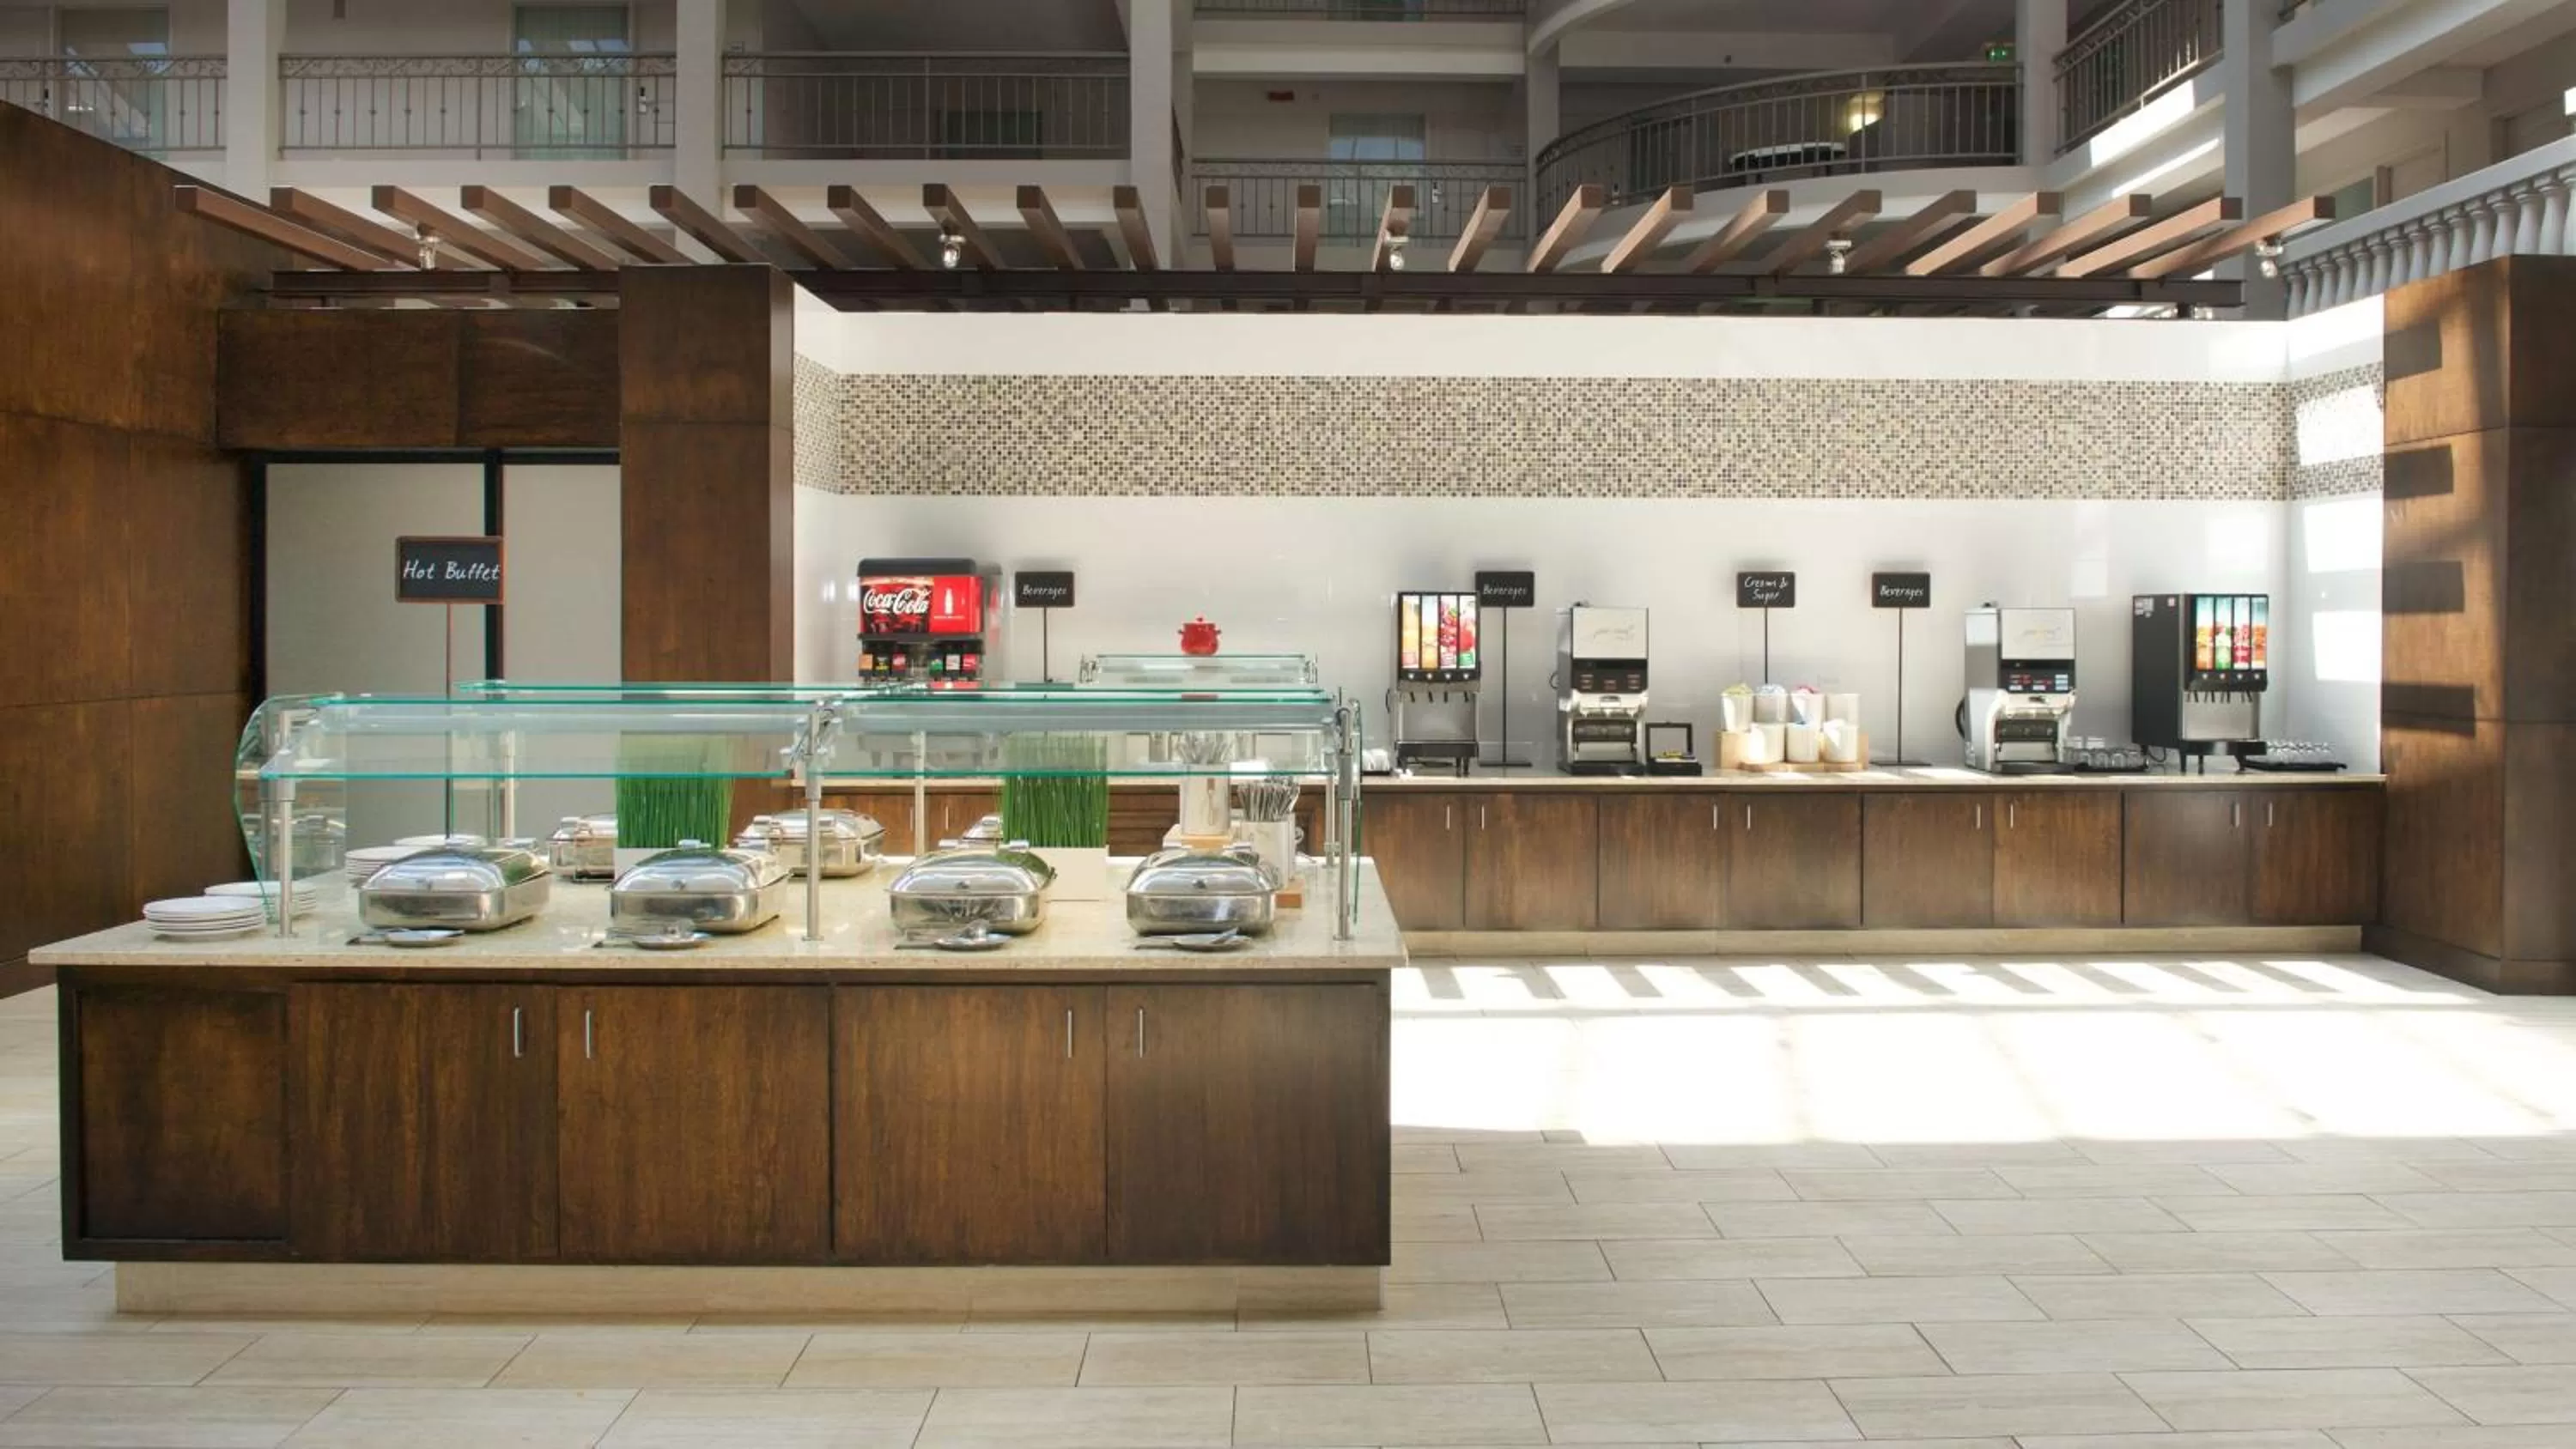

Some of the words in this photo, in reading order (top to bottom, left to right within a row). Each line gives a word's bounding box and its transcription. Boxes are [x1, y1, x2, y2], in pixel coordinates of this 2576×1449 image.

[403, 559, 435, 579] Hot
[444, 561, 501, 581] Buffet
[1022, 584, 1067, 601] Beverages
[1483, 584, 1528, 600] Beverages
[1752, 588, 1780, 605] Sugar
[1880, 585, 1924, 602] Beverages
